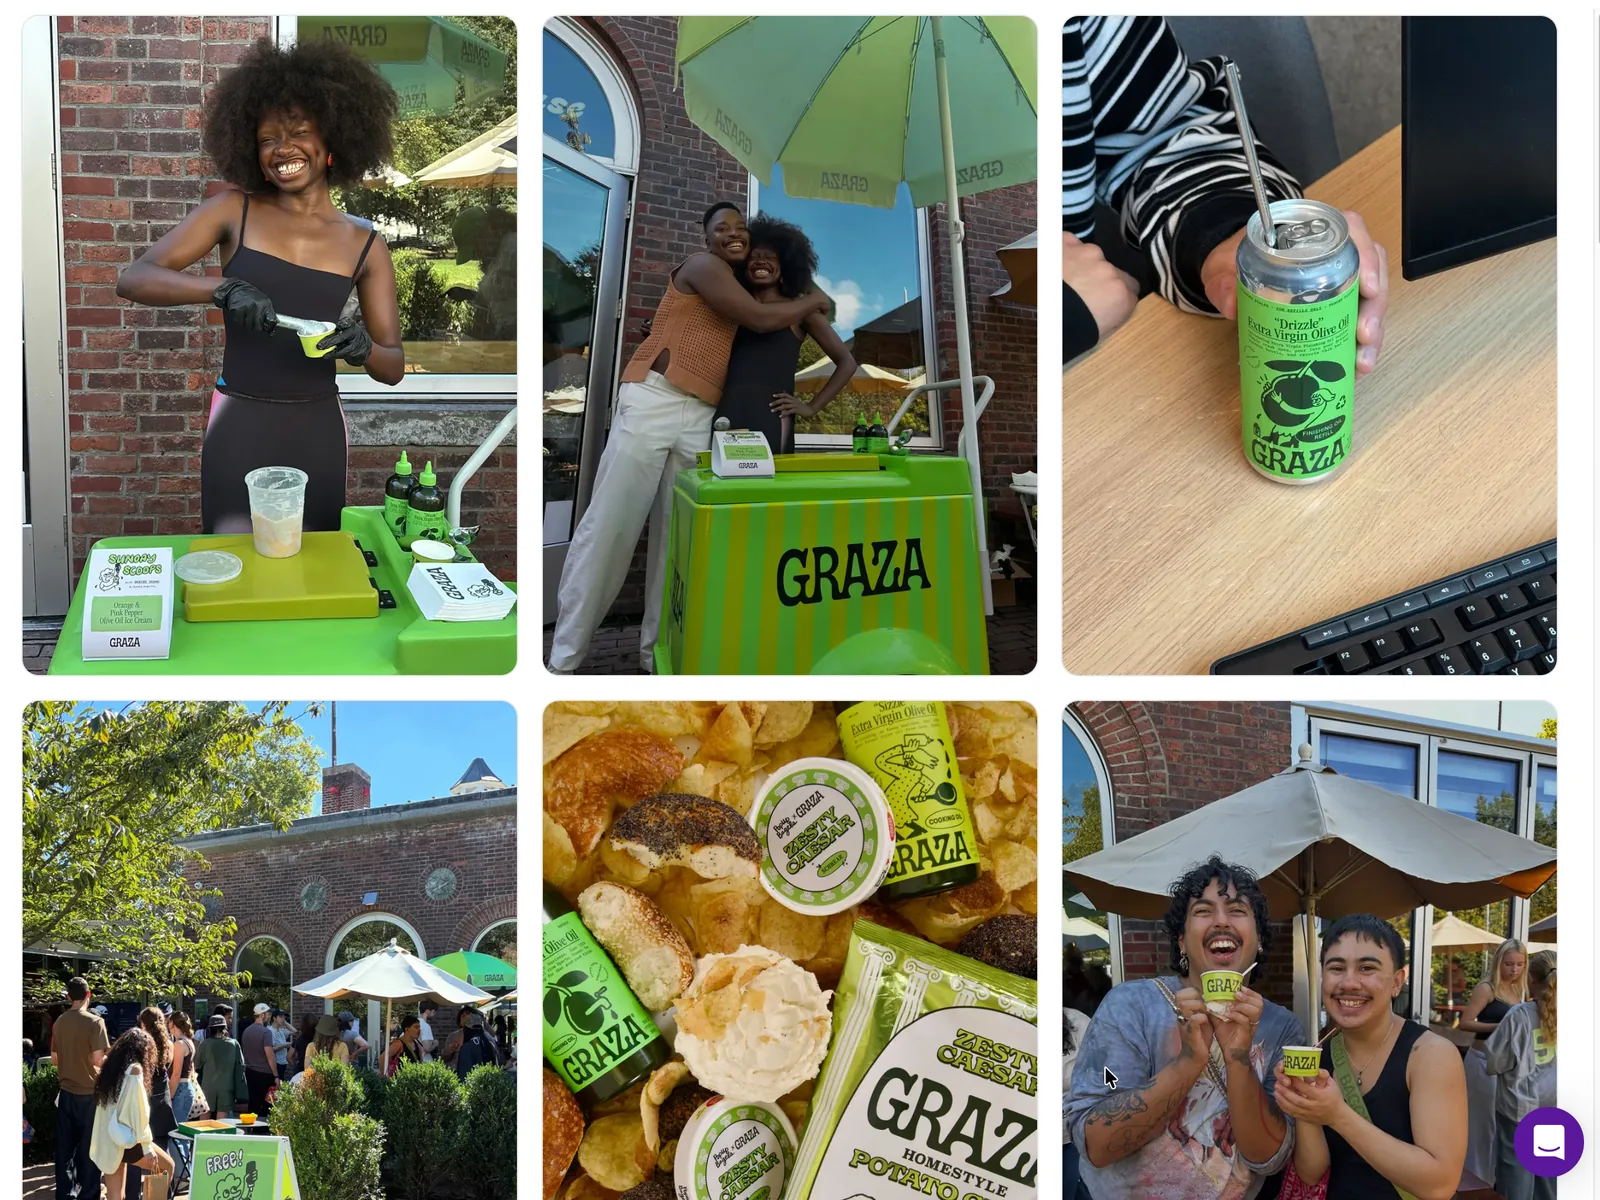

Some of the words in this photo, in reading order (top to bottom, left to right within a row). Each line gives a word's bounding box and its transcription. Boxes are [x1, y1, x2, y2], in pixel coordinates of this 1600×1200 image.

[1248, 316, 1271, 336] Extra
[1274, 329, 1308, 344] Virgin
[1311, 325, 1337, 339] Olive
[1338, 314, 1350, 329] Oil
[1274, 317, 1324, 330] “Drizzle”
[1302, 424, 1334, 436] FINISHING
[1334, 418, 1342, 427] OIL
[1314, 429, 1334, 440] REFILL
[1252, 437, 1345, 475] GRAZA
[108, 553, 157, 565] SUNDAY
[122, 564, 162, 576] SCOOPS
[776, 537, 932, 607] GRAZA
[426, 566, 465, 600] GRAZA
[1532, 581, 1540, 589] F7
[113, 602, 134, 610] Orange
[1466, 605, 1476, 613] F5
[124, 610, 143, 618] Pepper
[1410, 625, 1420, 633] F4
[1548, 627, 1556, 636] 8
[109, 637, 141, 648] GRAZA
[1376, 638, 1386, 646] F3
[1515, 639, 1522, 648] 7
[1340, 651, 1351, 659] F2
[1481, 652, 1490, 661] 6
[1545, 654, 1555, 664] U
[1447, 665, 1455, 674] 5
[850, 719, 872, 735] Extra
[873, 710, 903, 725] Virgin
[904, 704, 926, 718] Olive
[795, 790, 825, 818] GRAZA
[928, 815, 955, 826] COOKING
[783, 805, 838, 860] ZESTY
[786, 814, 856, 875] CAESAR
[544, 938, 567, 955] Olive
[565, 928, 579, 941] Oil
[484, 974, 505, 982] GRAZA
[1206, 978, 1242, 993] GRAZ
[562, 1015, 650, 1085] GRAZA
[867, 1066, 1037, 1188] GRAZ
[734, 1126, 760, 1150] GRAZA
[718, 1142, 767, 1189] ZESTY
[719, 1152, 780, 1200] CAESAR
[849, 1149, 959, 1200] POTATO
[902, 1148, 1009, 1197] HOMESTYLE
